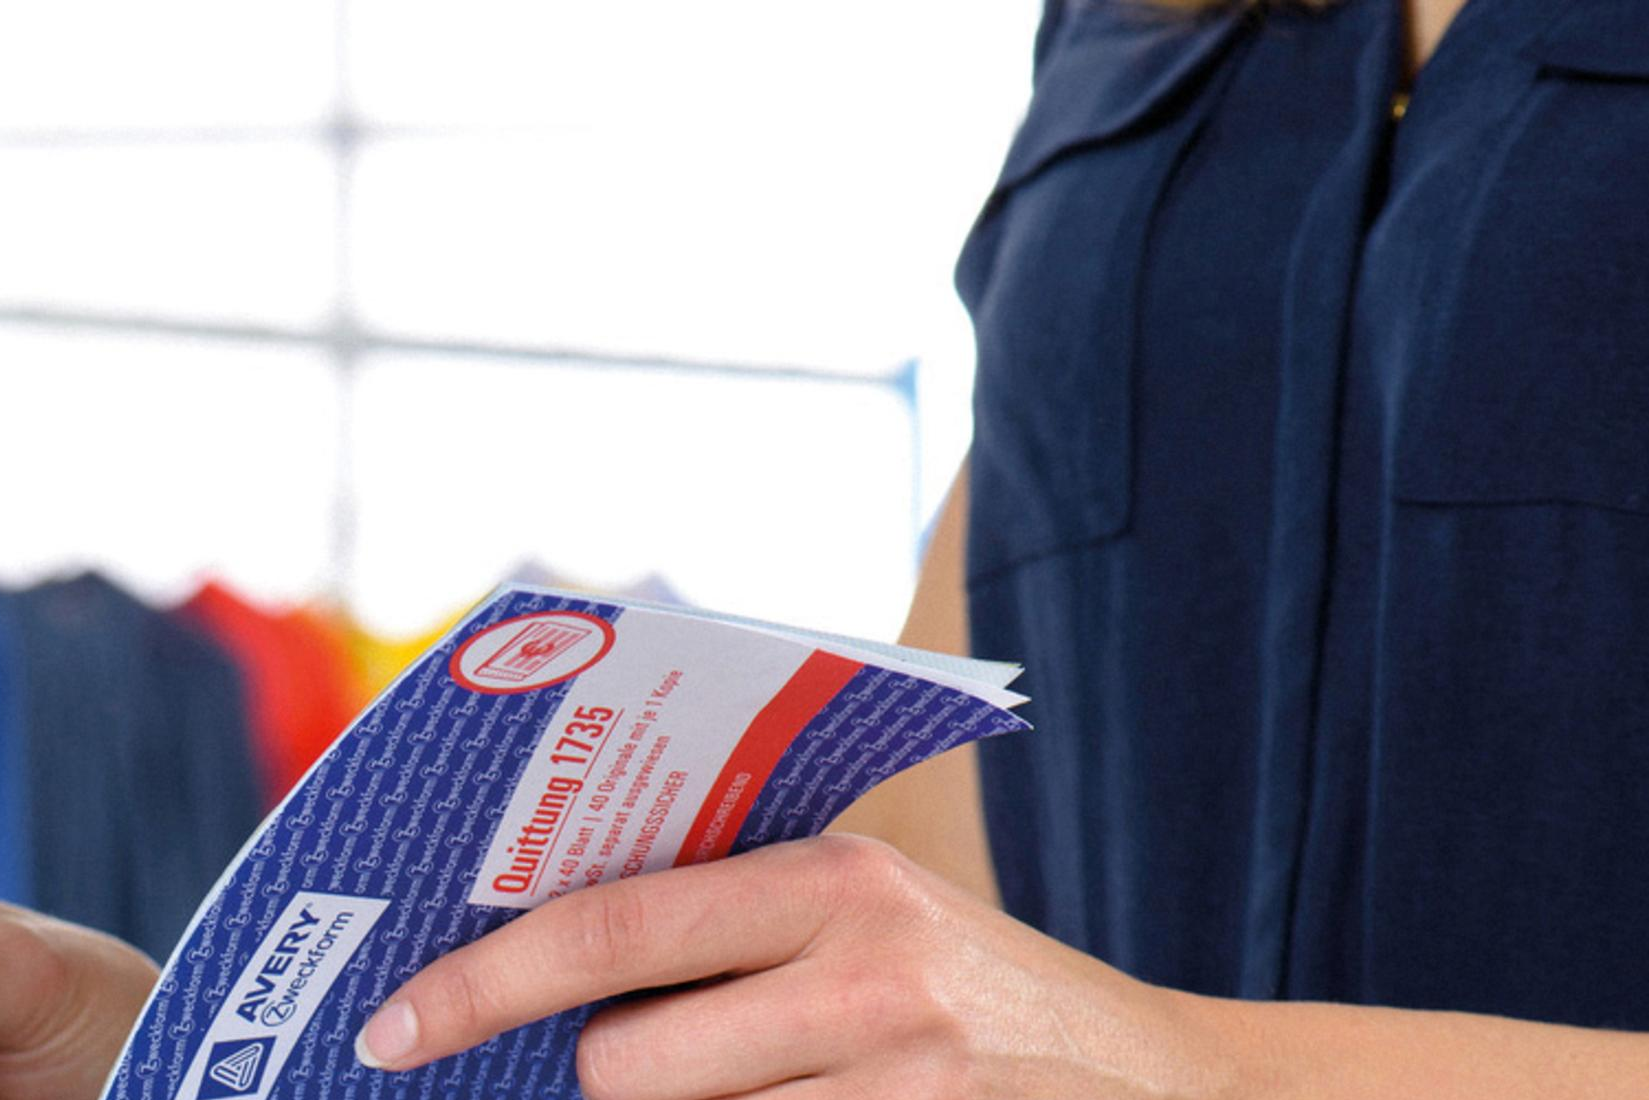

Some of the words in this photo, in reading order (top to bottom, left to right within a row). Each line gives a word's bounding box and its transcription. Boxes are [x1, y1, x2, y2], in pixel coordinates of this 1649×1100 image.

[651, 670, 683, 700] Kopie
[636, 710, 658, 722] je
[629, 722, 650, 741] mit
[597, 742, 638, 792] Originale
[492, 777, 584, 893] Quittung
[550, 706, 614, 764] 1735
[584, 862, 606, 888] wSt.
[599, 811, 631, 857] separat
[623, 735, 671, 809] ausgewiesen
[589, 794, 611, 812] 40
[619, 770, 689, 879] SCHUNGSSICHER
[567, 827, 595, 857] Blatt
[559, 859, 580, 876] 40
[558, 879, 570, 888] x
[235, 908, 321, 1023] AVERY
[260, 911, 355, 1027] Zweckform
